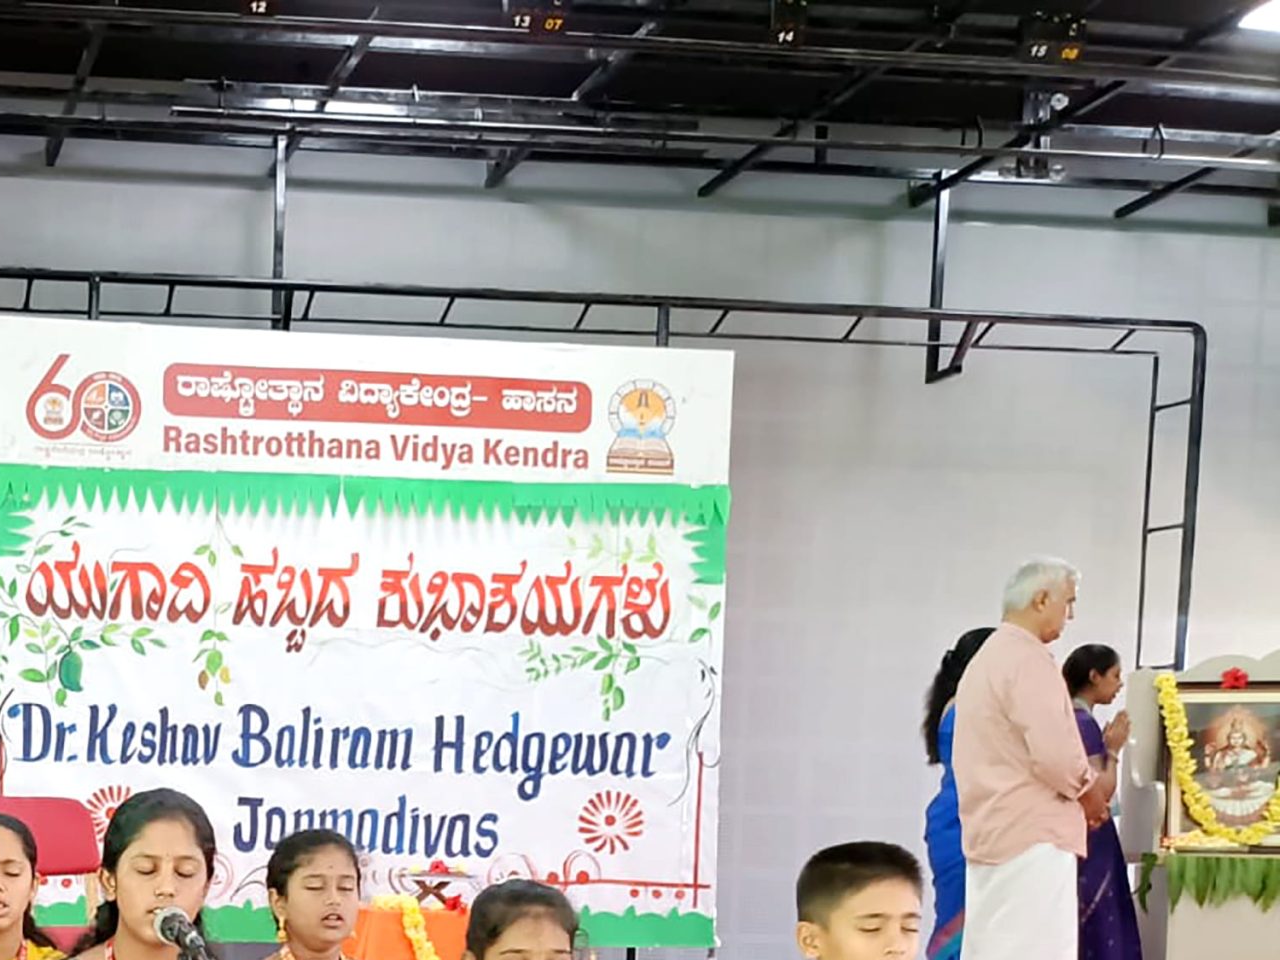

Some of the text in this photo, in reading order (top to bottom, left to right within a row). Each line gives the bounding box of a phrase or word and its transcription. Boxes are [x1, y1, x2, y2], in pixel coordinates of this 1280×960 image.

[501, 387, 578, 414] ಹಾಸನ
[163, 424, 381, 460] Rashtrotthana
[390, 434, 474, 470] Vidya
[483, 438, 589, 470] Kendra
[25, 540, 211, 623] ಯುಗಾದಿ
[232, 546, 360, 652] ಹಬ್ಬದ
[7, 702, 672, 802] Dr. Keshav Baliram Hedgewar
